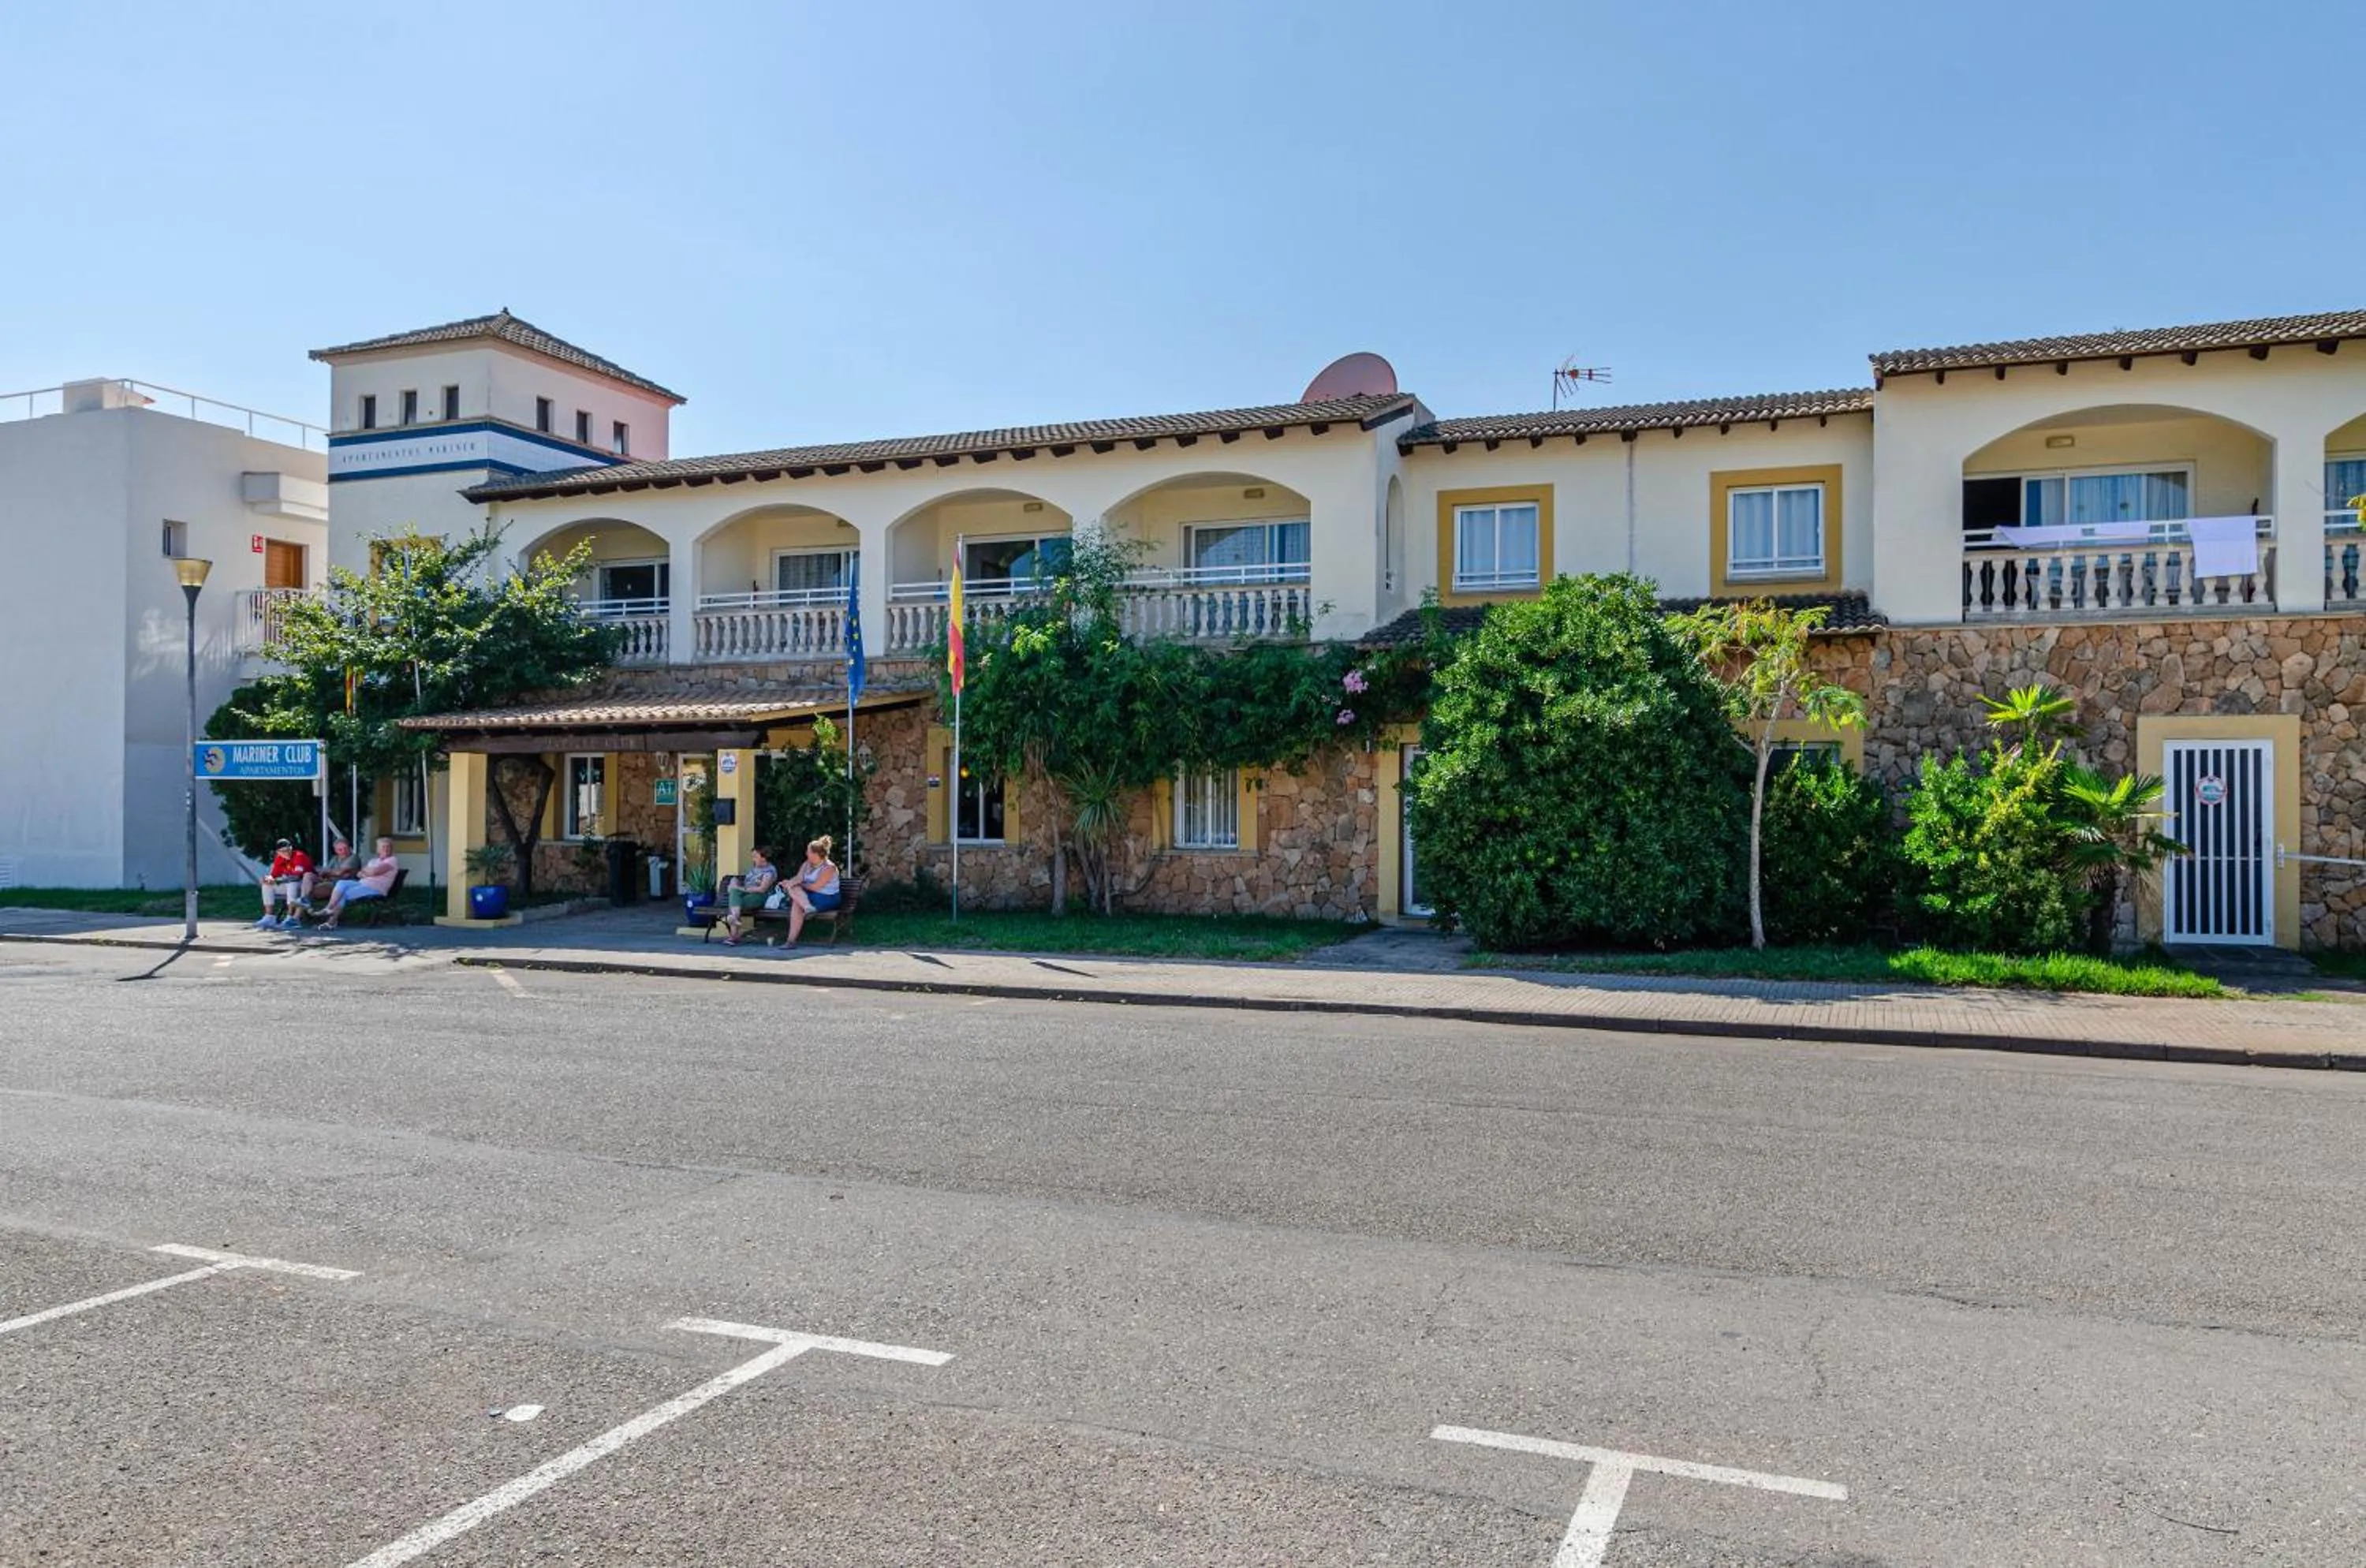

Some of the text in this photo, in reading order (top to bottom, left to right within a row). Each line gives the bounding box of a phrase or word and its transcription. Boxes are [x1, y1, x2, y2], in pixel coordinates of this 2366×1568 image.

[233, 745, 312, 763] MARINER CLUB
[240, 766, 305, 775] APARTAMENTOS
